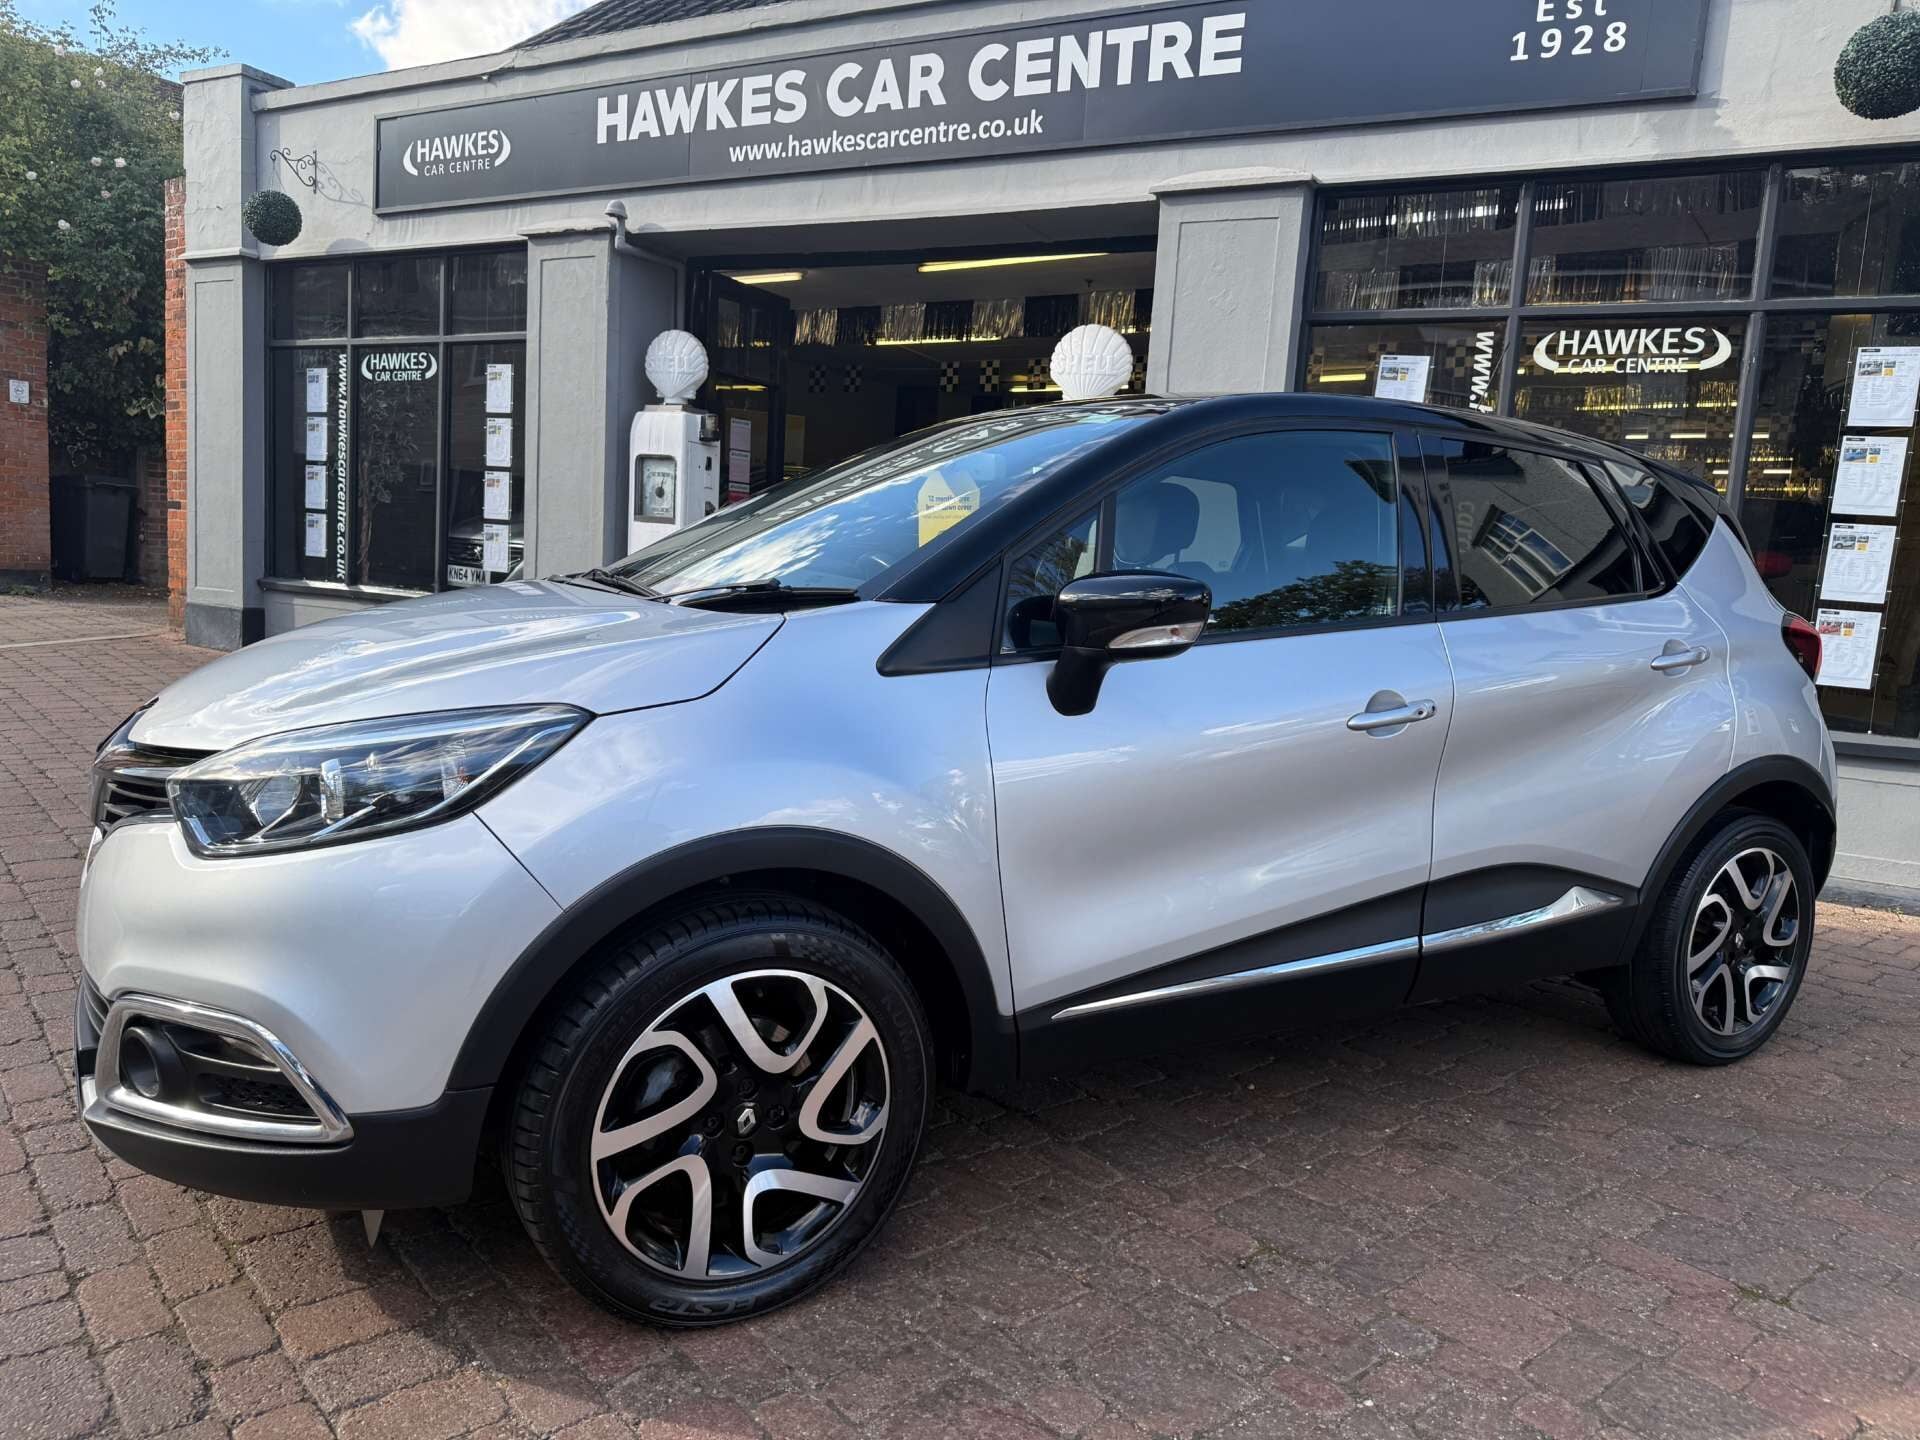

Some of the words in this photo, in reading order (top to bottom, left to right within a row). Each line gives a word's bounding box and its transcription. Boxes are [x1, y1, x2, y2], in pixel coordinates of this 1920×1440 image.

[1536, 0, 1607, 22] Est
[1510, 21, 1627, 61] 1928
[597, 70, 808, 145] HAWKES
[825, 52, 946, 118] CAR
[968, 12, 1247, 101] CENTRE
[417, 130, 499, 163] HAWKES
[729, 108, 1044, 162] www.hawkescarcentre.co.uk
[424, 164, 445, 176] CAR
[449, 158, 491, 174] CENTRE
[1558, 327, 1707, 356] HAWKES
[370, 352, 428, 370] HAWKES
[1056, 352, 1121, 376] SHELL
[1567, 358, 1607, 374] CAR
[1614, 357, 1689, 374] CENTRE
[374, 371, 391, 382] CAR
[392, 370, 422, 382] CENTRE
[337, 353, 348, 580] www.hawkescarcentre.co.uk
